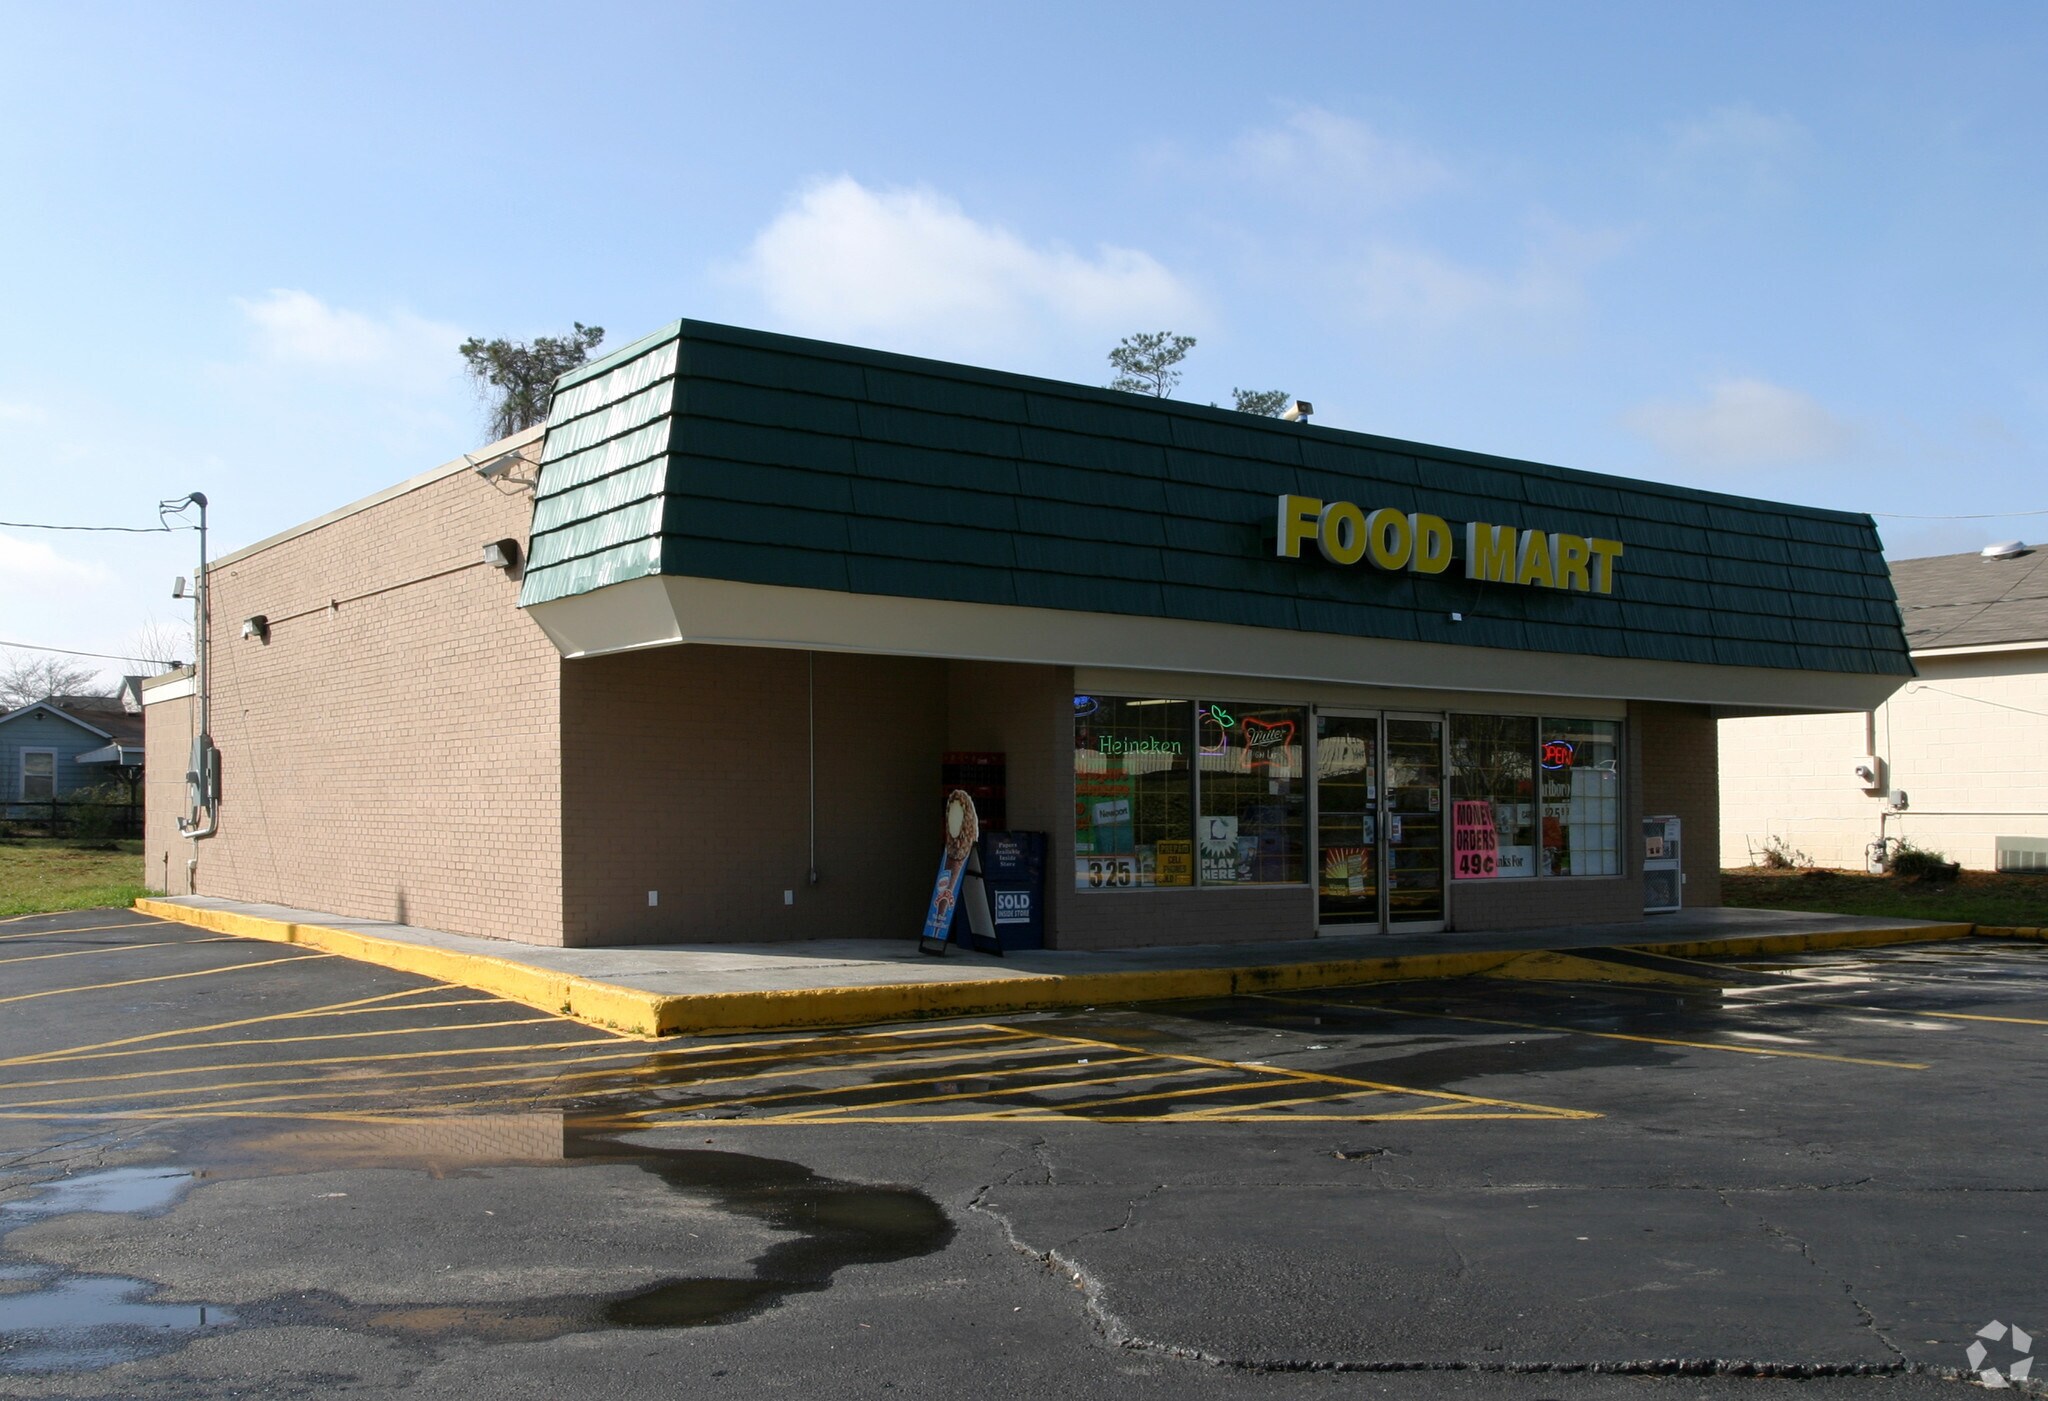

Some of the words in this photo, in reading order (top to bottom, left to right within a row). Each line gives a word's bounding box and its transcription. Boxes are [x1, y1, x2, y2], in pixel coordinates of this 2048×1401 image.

[1277, 494, 1453, 574] FOOD
[1466, 521, 1623, 594] MART
[1099, 736, 1182, 755] Heineken
[1541, 744, 1573, 766] OPEN
[1099, 808, 1128, 819] Newport
[1457, 804, 1493, 826] MONEY
[1457, 829, 1495, 851] ORDERS
[1202, 858, 1235, 869] PLAY
[1460, 854, 1494, 875] 49¢
[1512, 855, 1523, 867] For
[1090, 861, 1131, 888] 325
[1202, 869, 1235, 880] HERE
[998, 895, 1030, 909] SOLD
[1015, 909, 1030, 917] STORE
